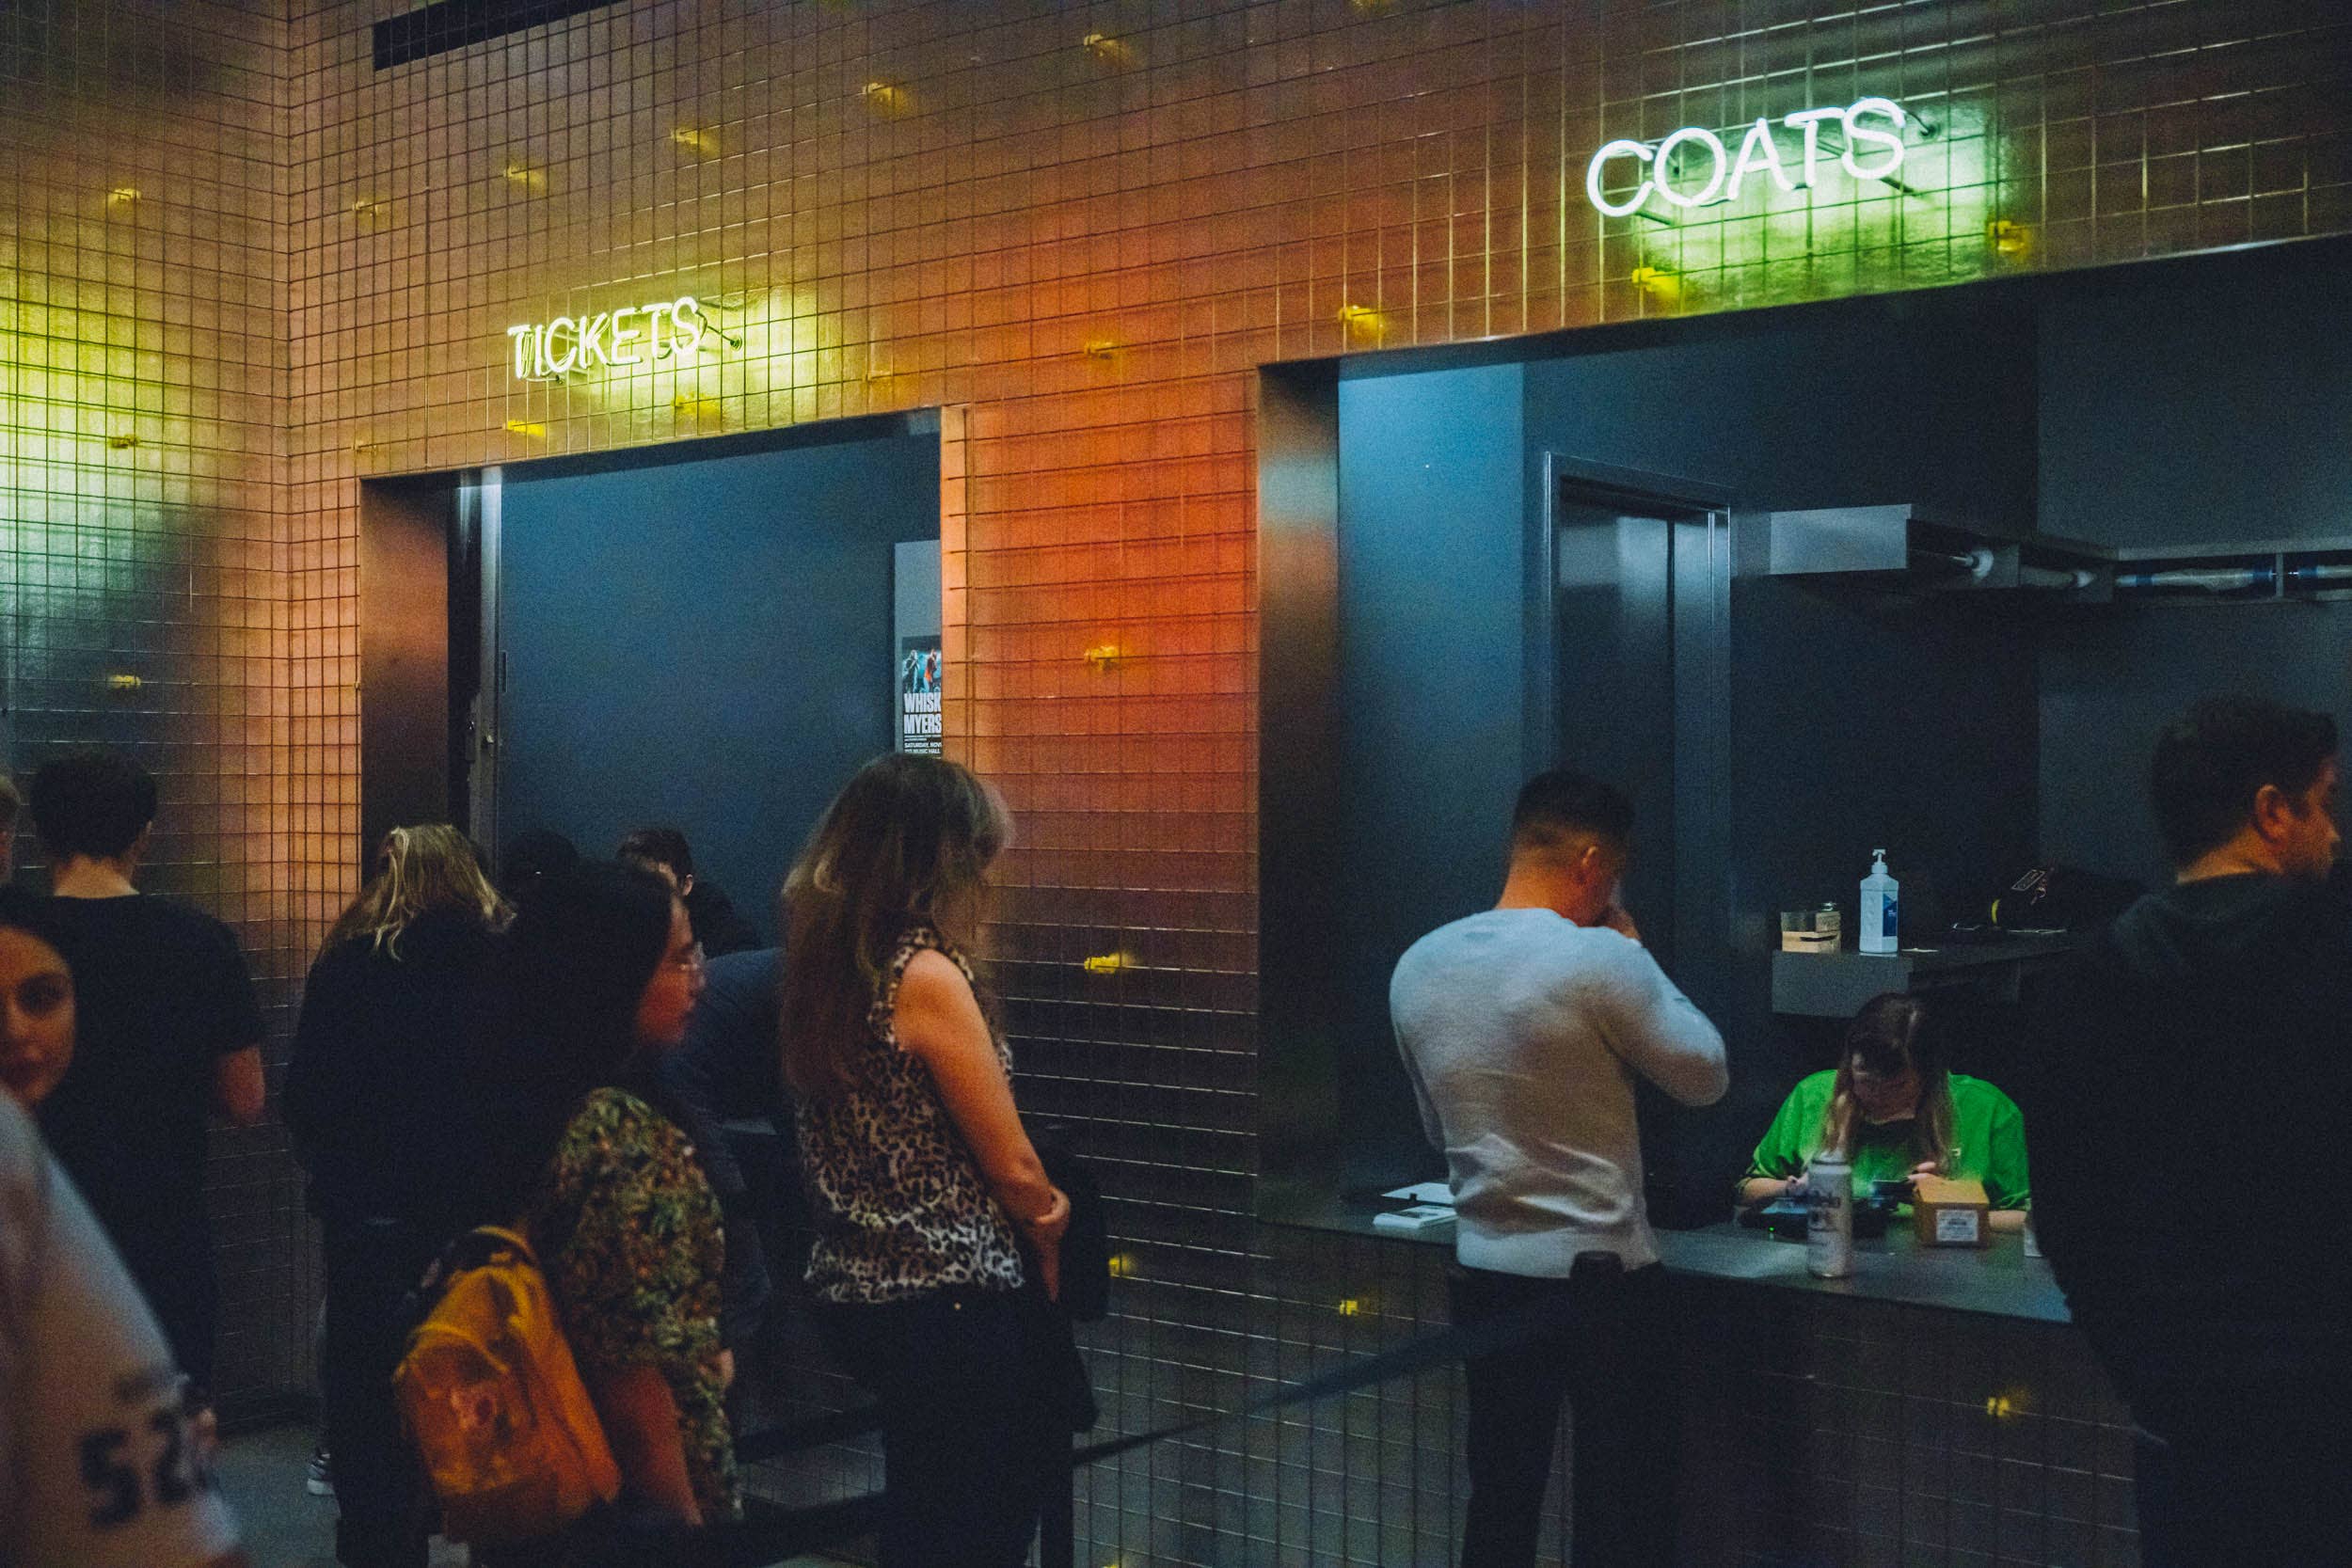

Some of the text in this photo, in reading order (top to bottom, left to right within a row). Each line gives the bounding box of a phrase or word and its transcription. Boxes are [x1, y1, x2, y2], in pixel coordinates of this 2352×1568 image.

[1586, 96, 1907, 217] COATS
[507, 296, 700, 378] TICKETS
[904, 714, 942, 734] MYERS
